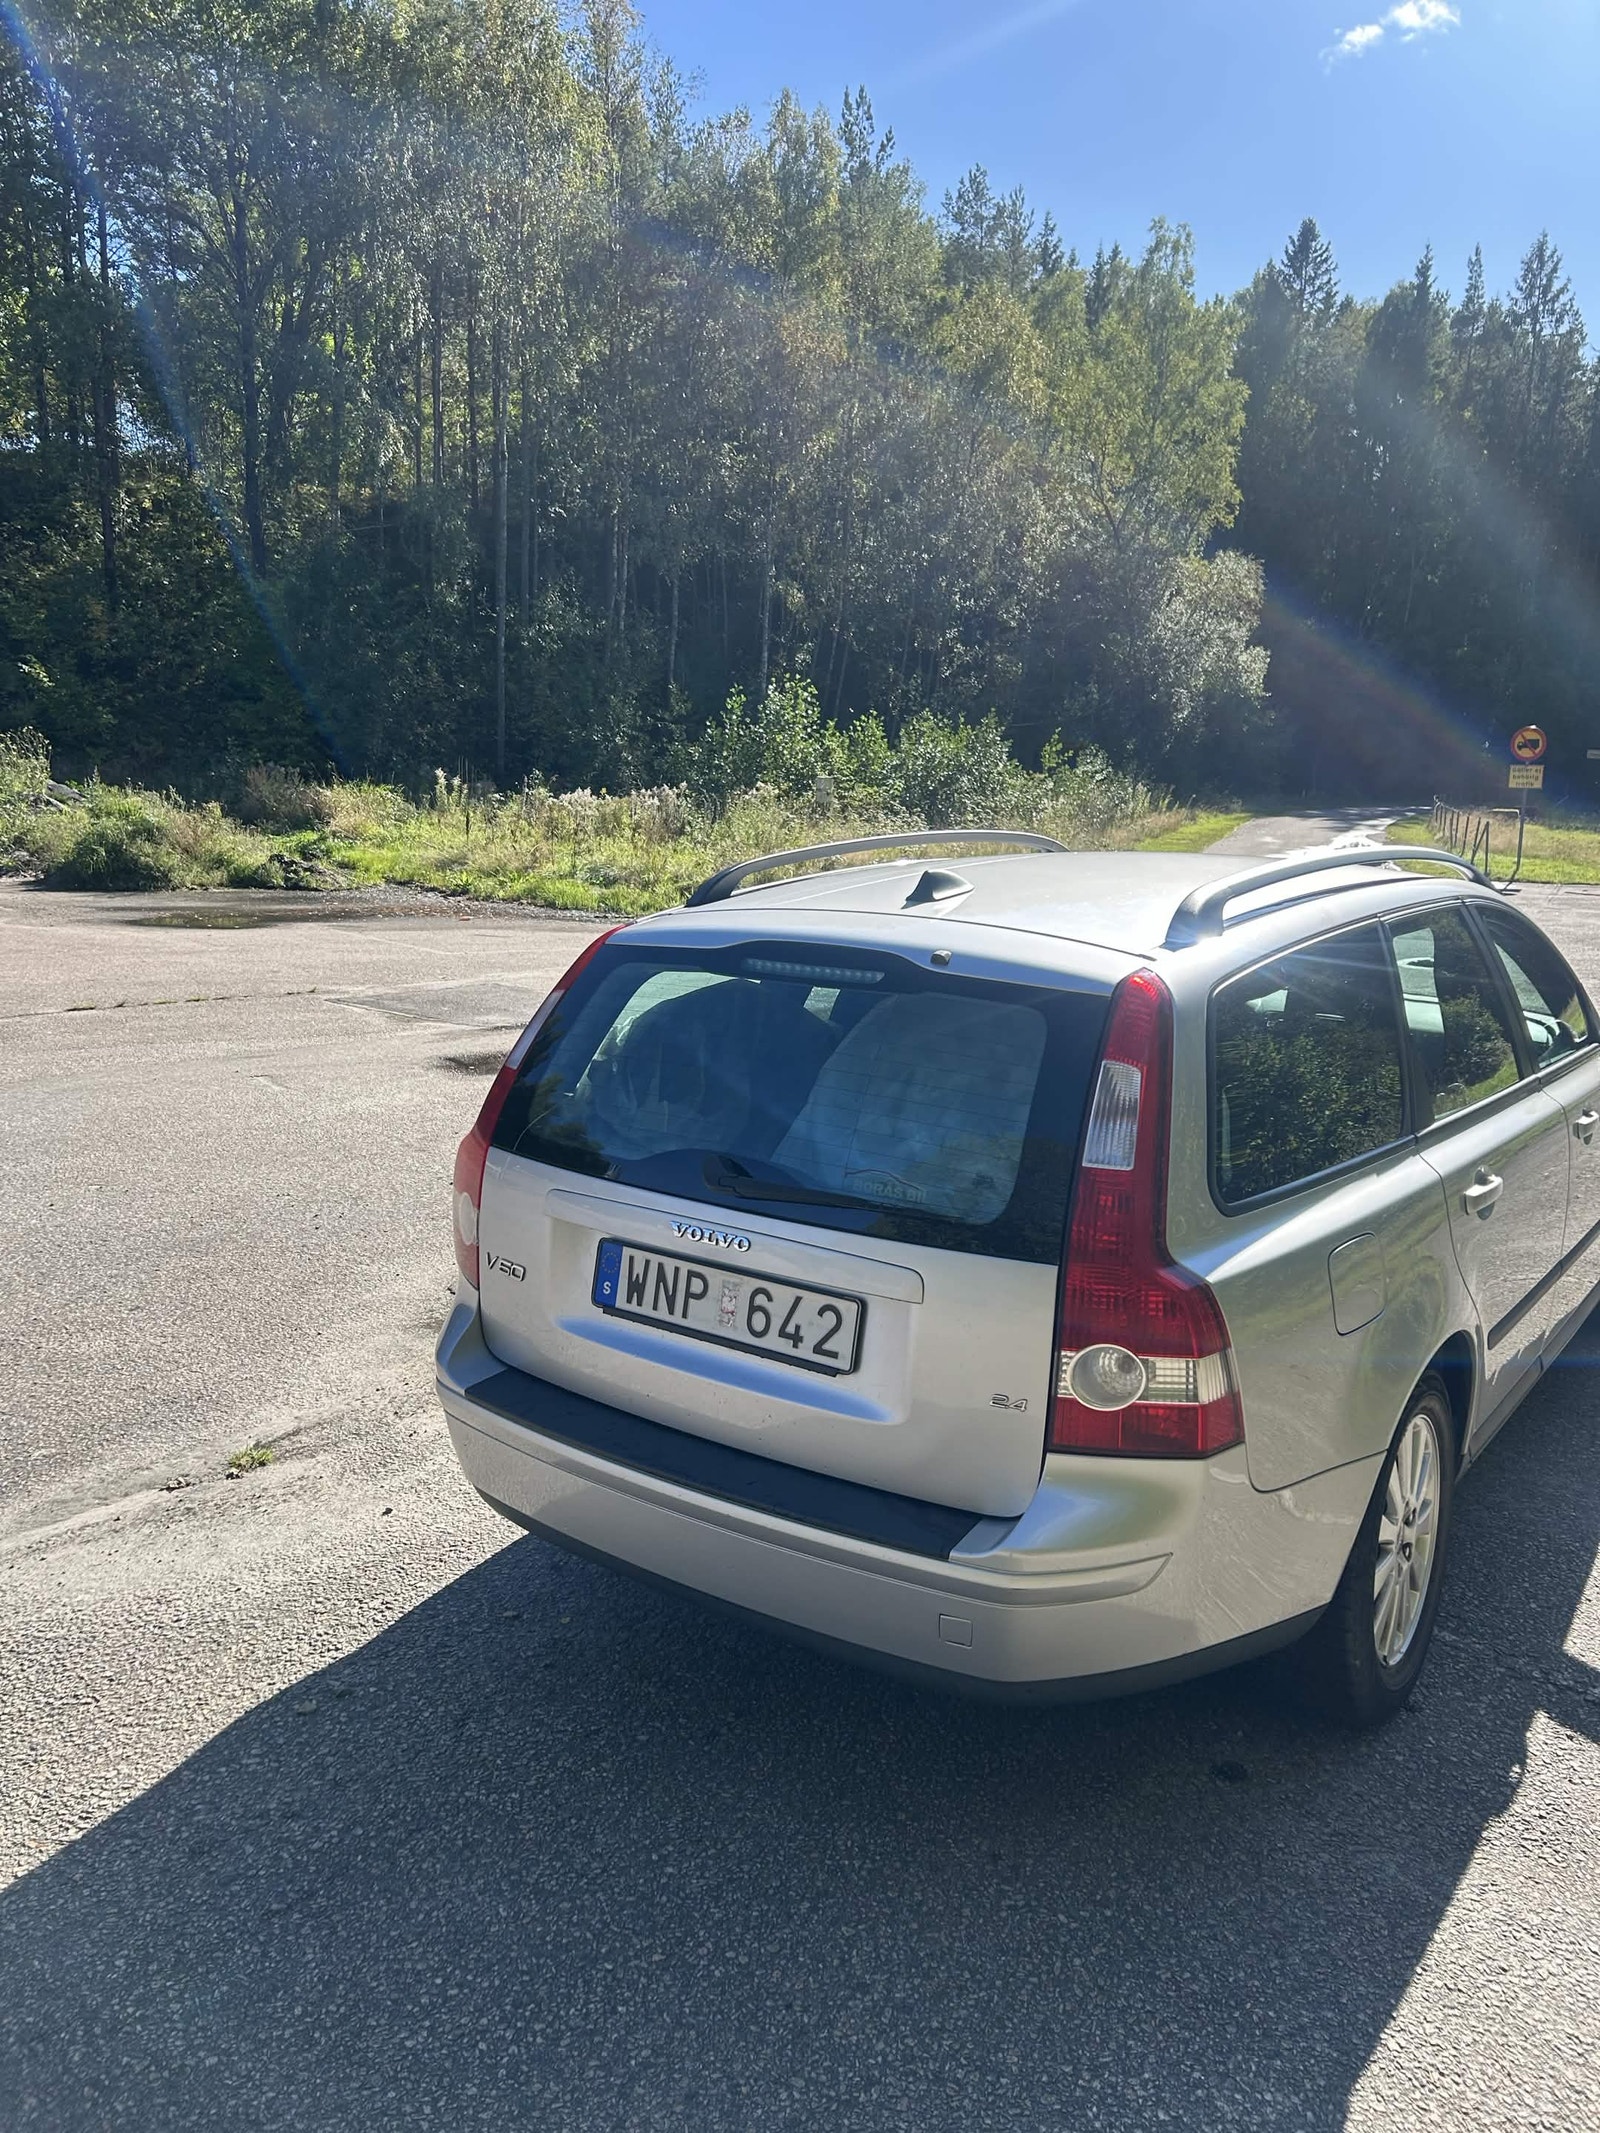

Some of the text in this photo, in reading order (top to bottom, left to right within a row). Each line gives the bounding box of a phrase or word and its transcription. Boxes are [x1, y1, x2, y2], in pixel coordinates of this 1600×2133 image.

[669, 1220, 750, 1252] VOLVO
[486, 1251, 526, 1281] V50
[603, 1281, 611, 1294] S
[626, 1255, 843, 1359] WNP 642
[990, 1393, 1028, 1412] 2.4
